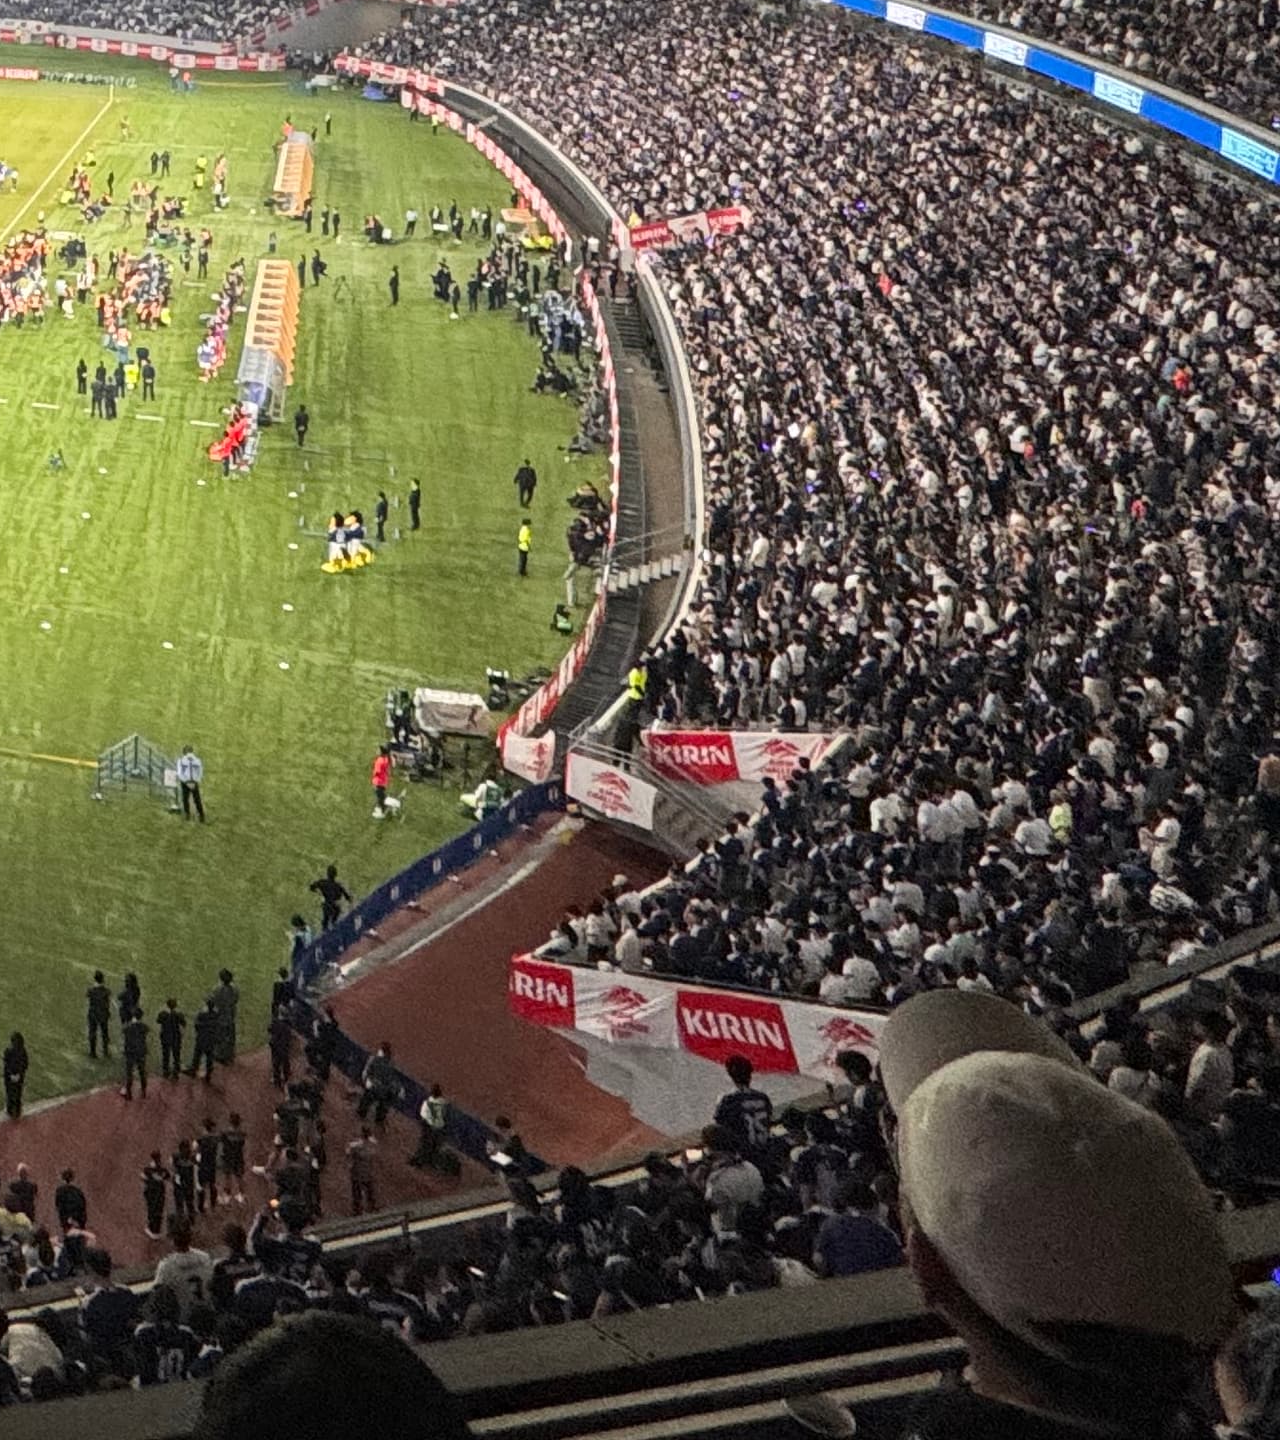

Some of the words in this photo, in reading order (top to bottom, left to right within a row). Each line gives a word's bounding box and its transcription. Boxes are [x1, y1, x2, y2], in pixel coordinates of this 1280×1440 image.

[653, 743, 732, 767] KIRIN
[511, 970, 569, 1007] RIN
[679, 1006, 787, 1051] KIRIN
